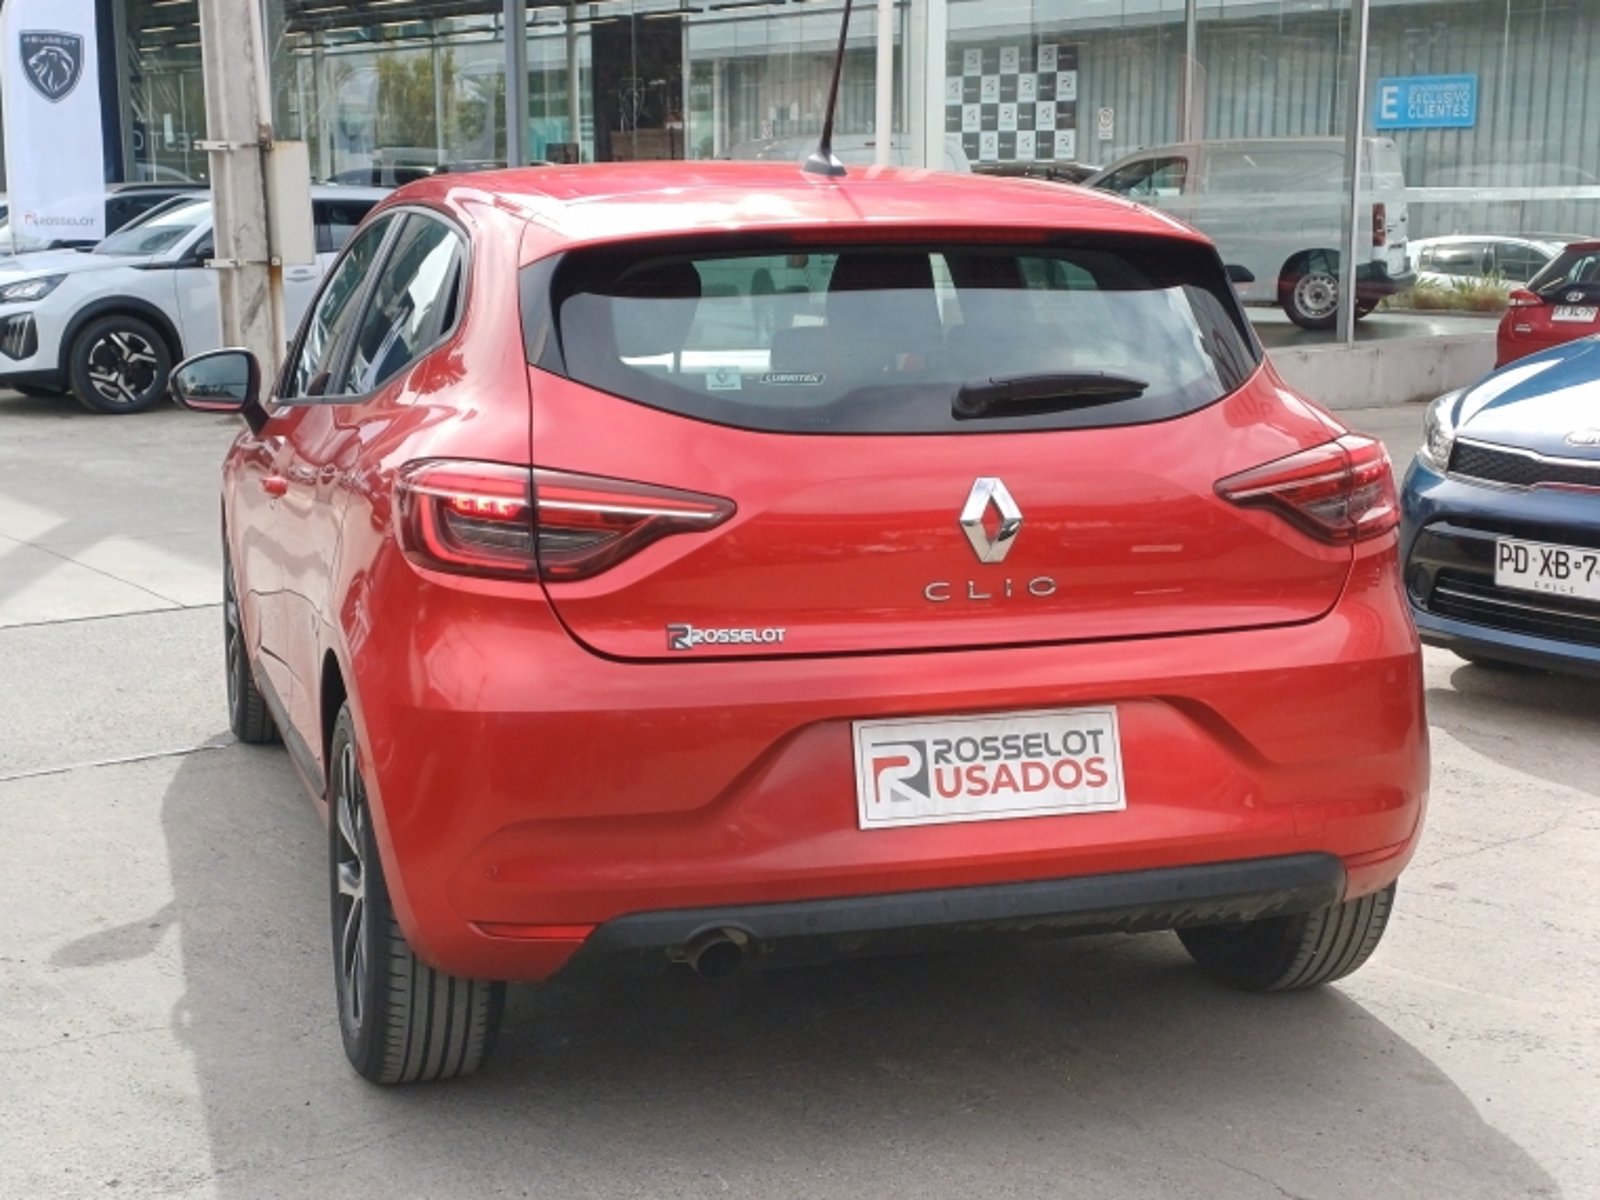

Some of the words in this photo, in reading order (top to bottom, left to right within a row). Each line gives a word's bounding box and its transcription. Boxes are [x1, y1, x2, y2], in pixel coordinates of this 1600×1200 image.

[1381, 86, 1399, 119] E
[1408, 104, 1469, 119] CLIENTES
[924, 576, 1057, 601] CLIO
[692, 628, 786, 643] ROSSELOT
[932, 729, 1104, 765] ROSSELOT
[934, 756, 1109, 798] USADOS
